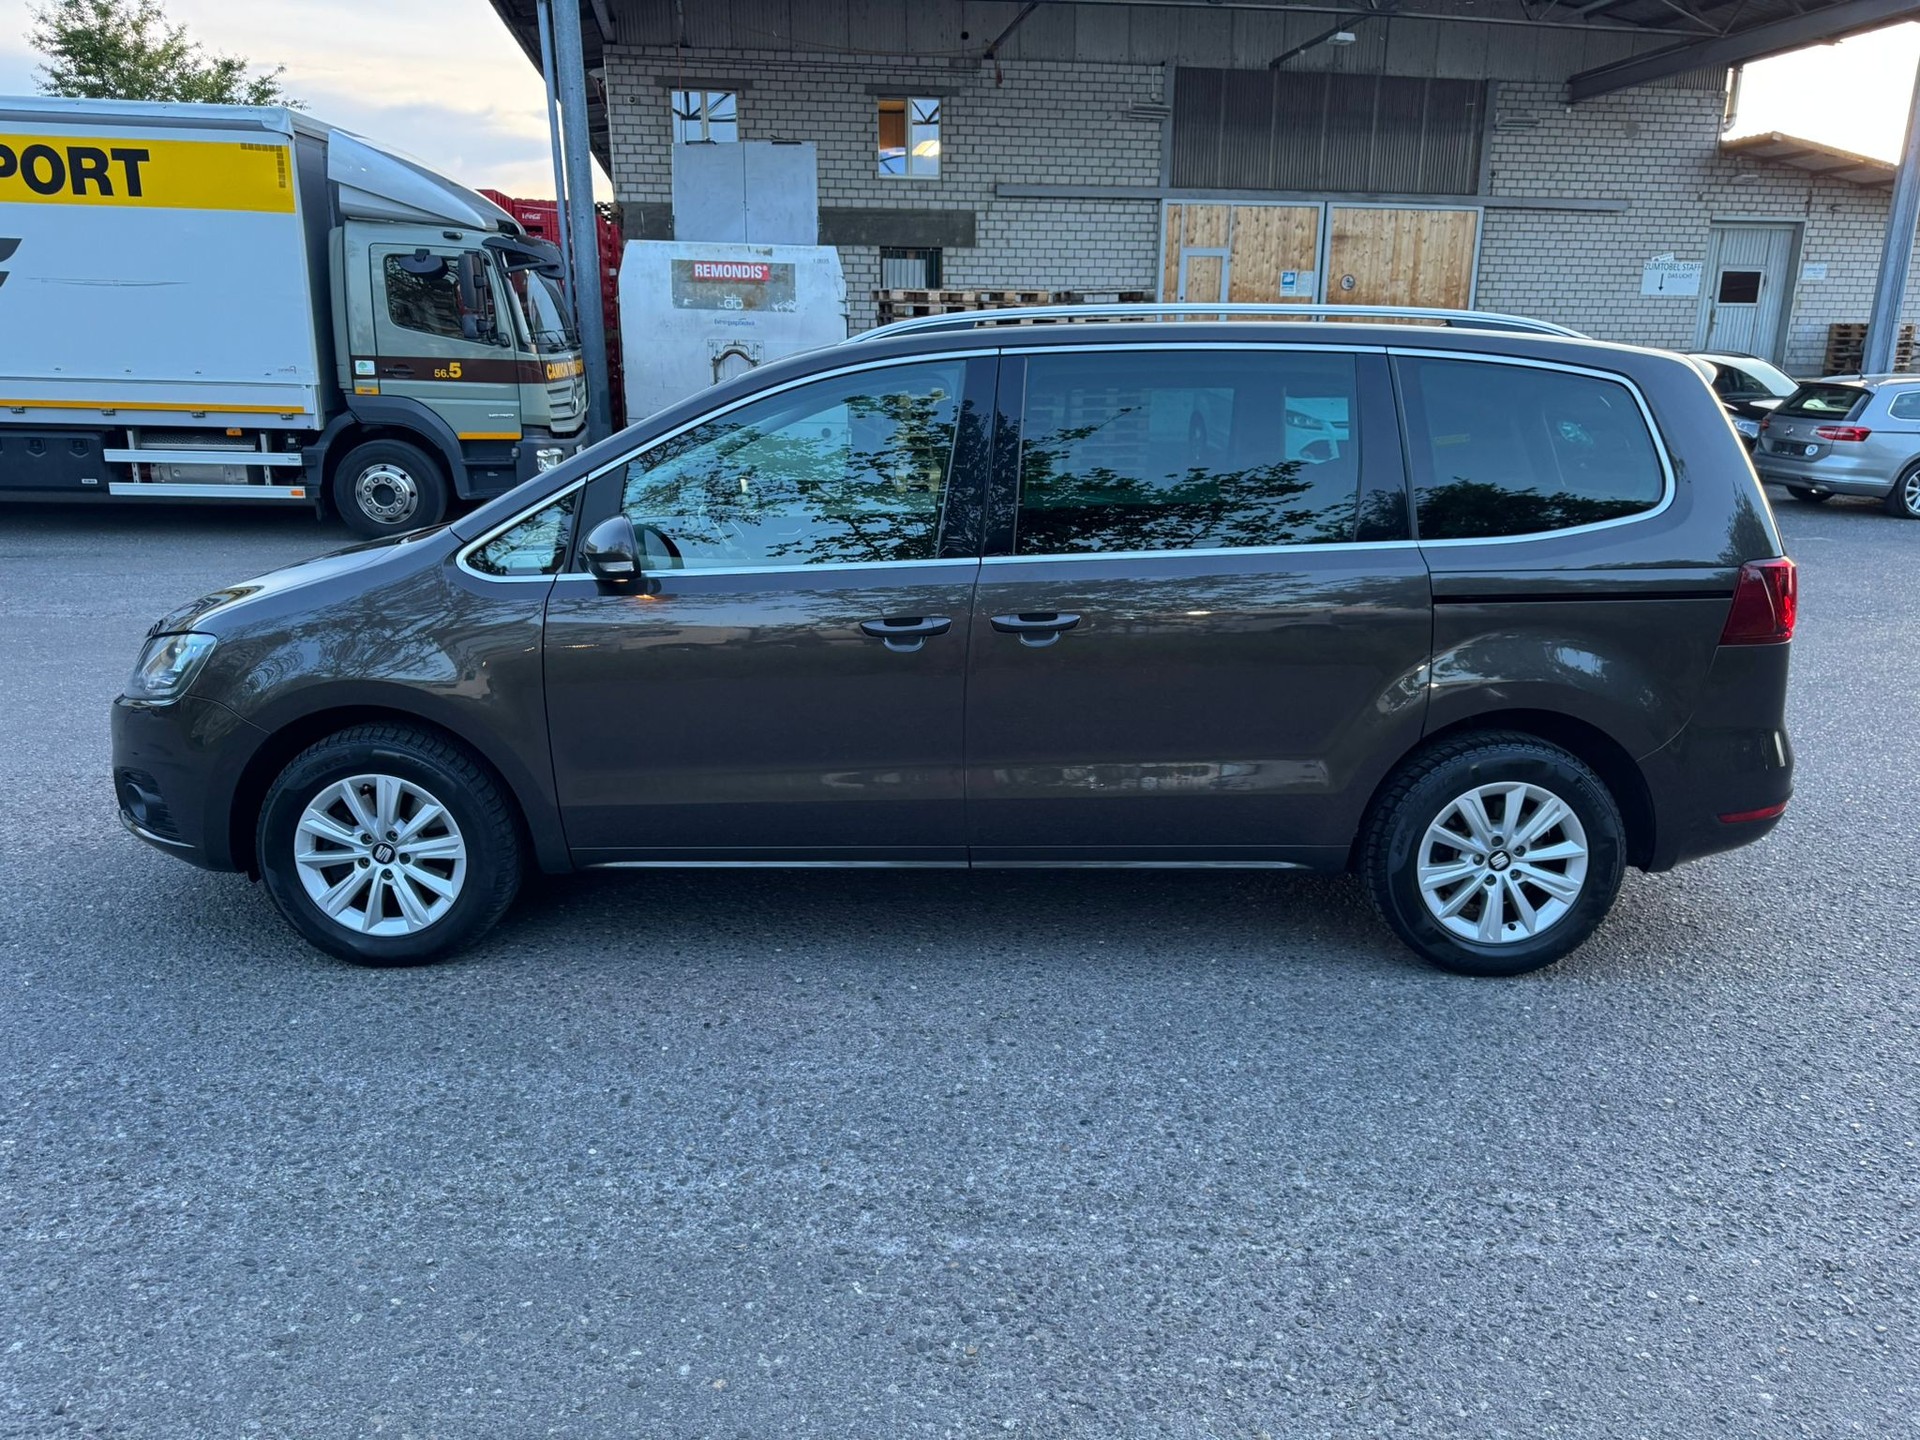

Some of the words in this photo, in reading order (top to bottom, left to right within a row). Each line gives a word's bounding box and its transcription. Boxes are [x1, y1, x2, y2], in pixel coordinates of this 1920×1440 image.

[1644, 262, 1680, 271] ZUMTOBEL
[1682, 263, 1702, 271] STAFF
[434, 362, 462, 378] 56.5
